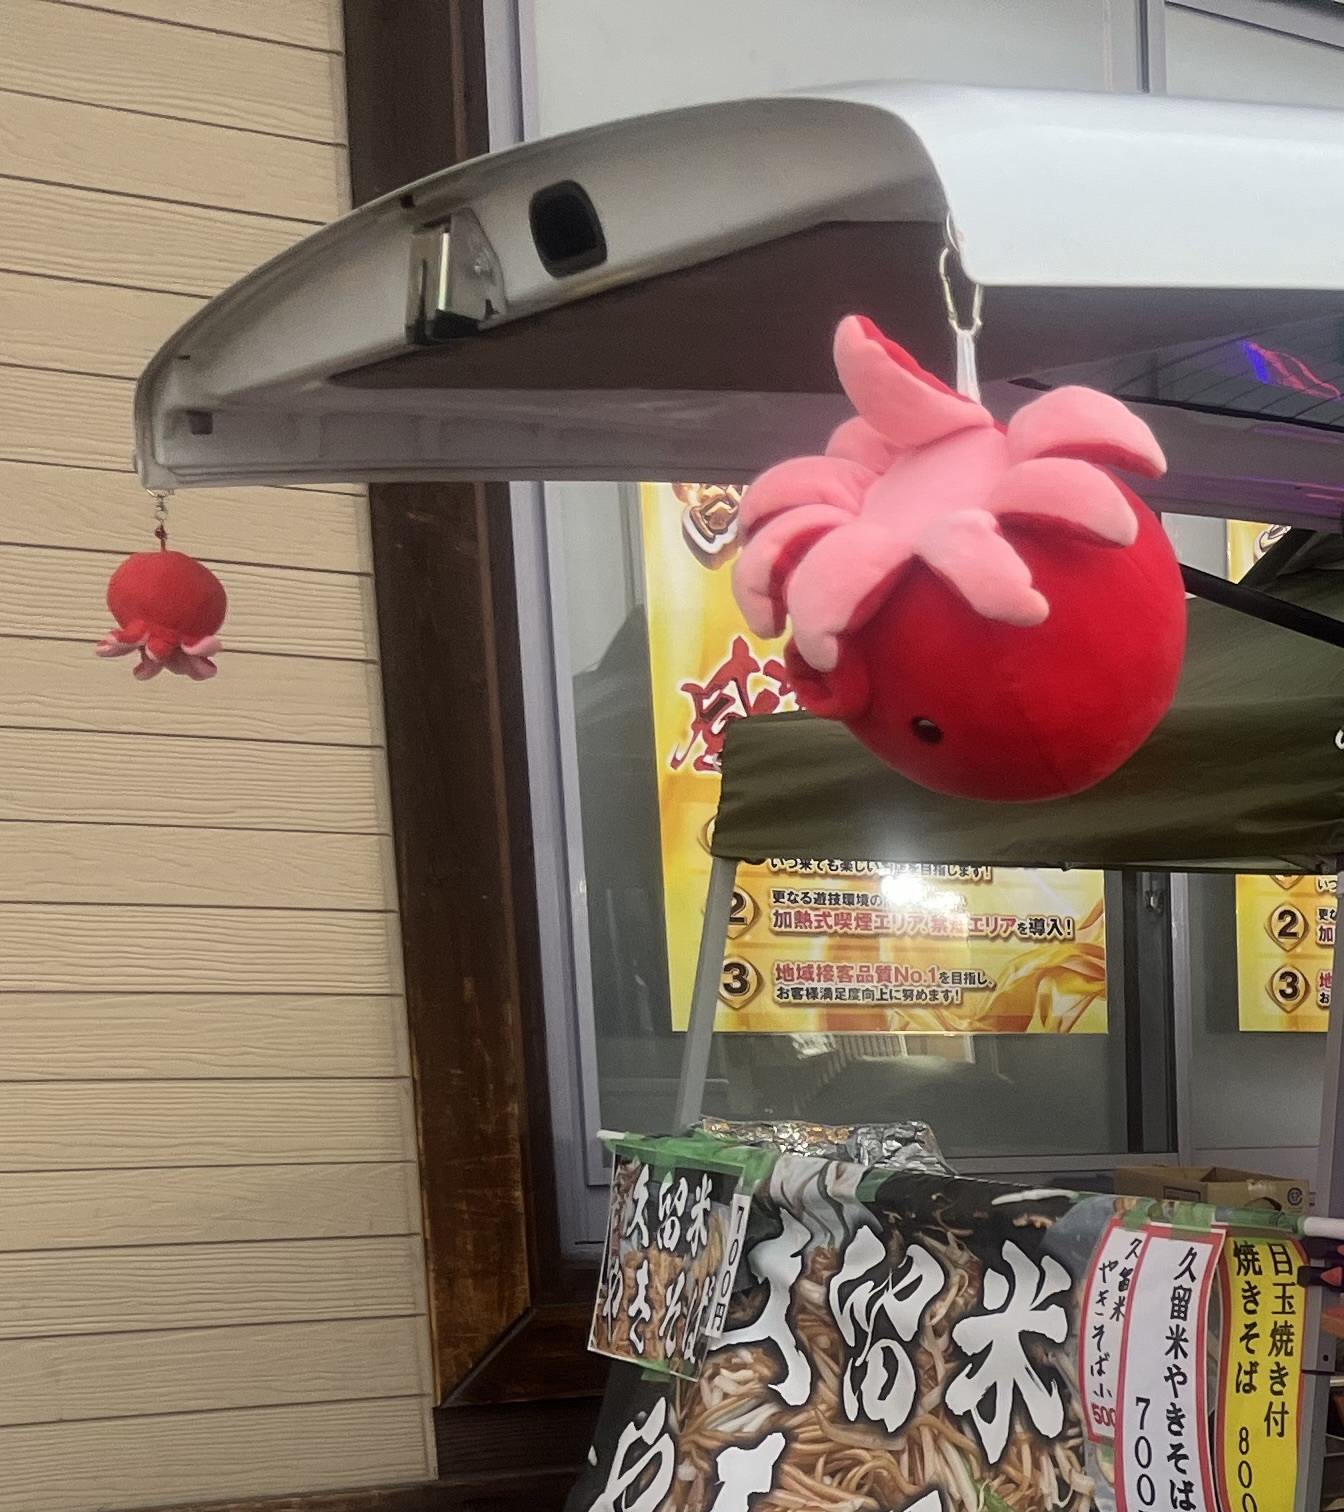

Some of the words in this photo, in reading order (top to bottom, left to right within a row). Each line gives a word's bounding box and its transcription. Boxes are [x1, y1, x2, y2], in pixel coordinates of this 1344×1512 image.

[723, 961, 748, 995] 3
[1276, 909, 1299, 939] 2
[1278, 971, 1299, 1000] 3
[710, 1204, 746, 1332] 700円
[1232, 1241, 1263, 1395] 焼きそば
[1163, 1246, 1197, 1512] 久留米やきそば
[1263, 1241, 1296, 1438] 目玉焼き付
